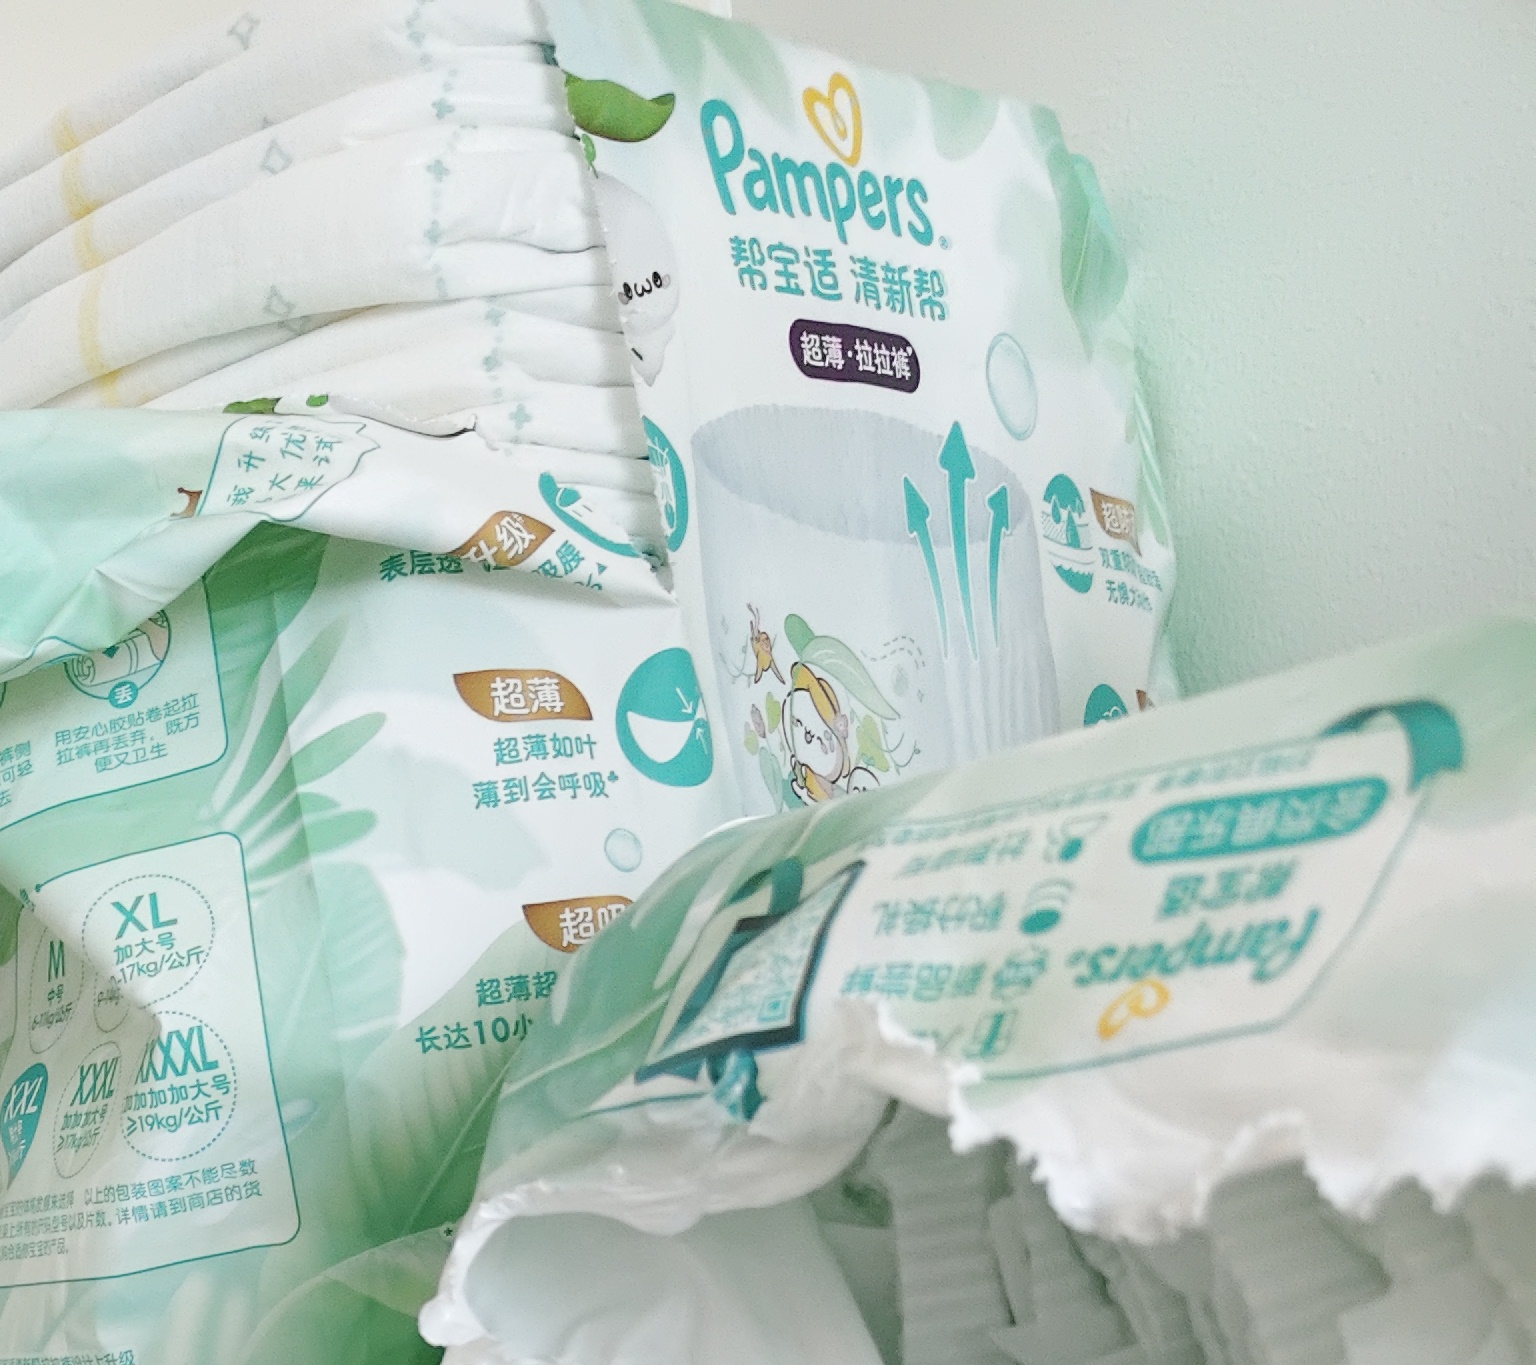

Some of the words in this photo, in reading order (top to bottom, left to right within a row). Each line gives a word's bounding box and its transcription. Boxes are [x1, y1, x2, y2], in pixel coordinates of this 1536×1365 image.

[699, 98, 934, 247] Pampers
[730, 234, 843, 302] 帮宝适
[850, 256, 948, 322] 清新帮
[489, 676, 565, 717] 超薄
[54, 692, 200, 748] 用安心胶贴卷起拉
[94, 742, 168, 774] 便又卫生
[492, 734, 598, 767] 超薄如叶
[471, 770, 611, 811] 薄到会呼吸
[110, 891, 179, 941] XL
[47, 939, 65, 983] M
[113, 931, 177, 966] 加大号
[416, 1012, 534, 1055] 长达10小
[3, 1076, 44, 1124] XXL
[125, 1099, 223, 1138] ≥19kg/公斤
